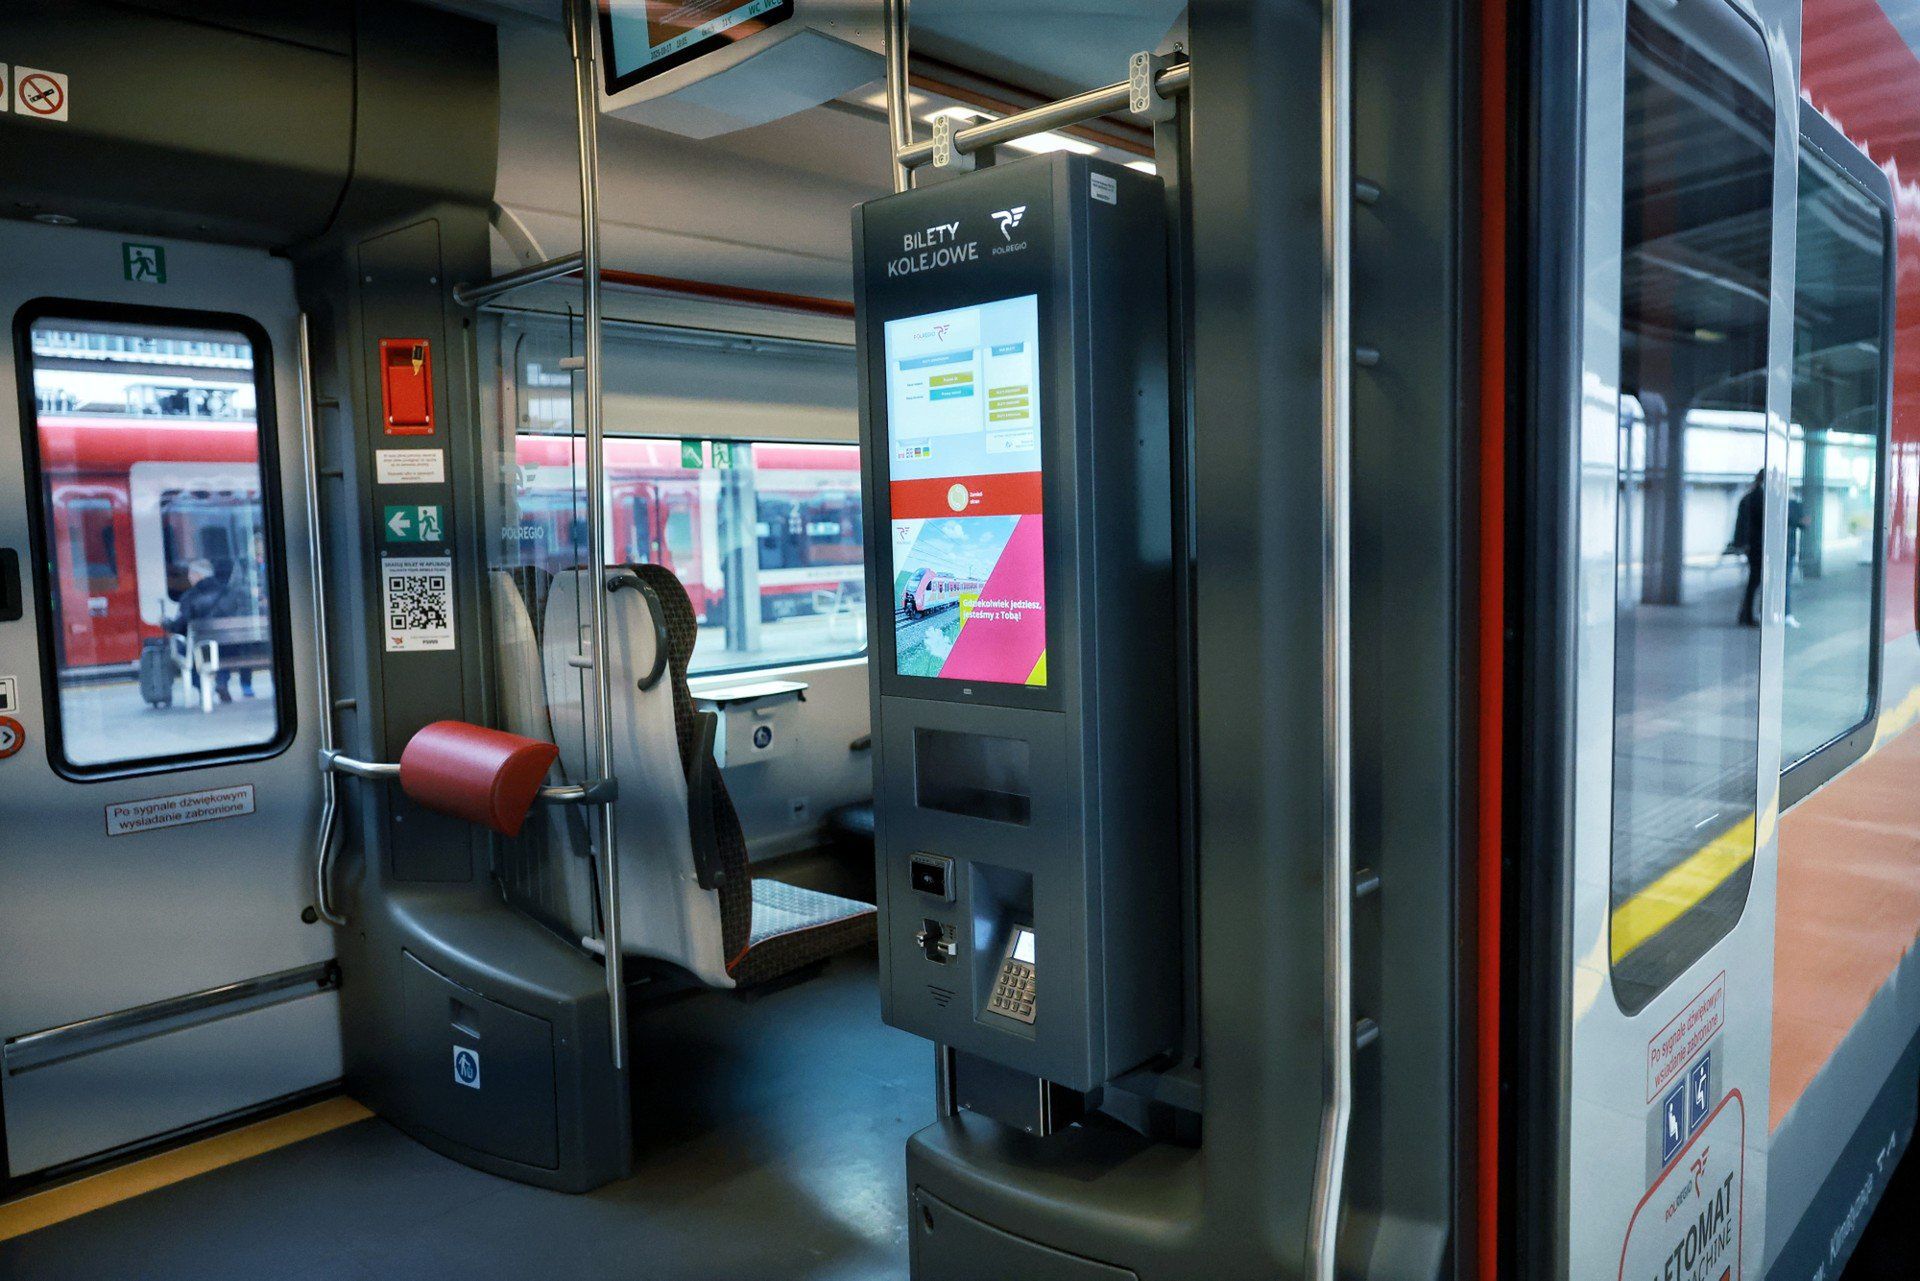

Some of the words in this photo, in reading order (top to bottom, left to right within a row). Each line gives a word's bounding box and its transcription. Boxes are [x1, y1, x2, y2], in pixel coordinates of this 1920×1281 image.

[748, 2, 761, 15] WC
[903, 221, 960, 252] BILETY
[991, 241, 1027, 256] POLREGIO
[887, 241, 979, 278] KOLEJOWE
[501, 526, 545, 540] POLREGIO
[963, 599, 1010, 609] Gdziekolwiek
[114, 807, 130, 817] Po
[133, 800, 177, 816] sygnale
[179, 790, 247, 808] dźwiękowym
[185, 802, 244, 819] zabronione
[1650, 1048, 1660, 1067] Po
[1662, 1022, 1686, 1058] sygnale
[1687, 1013, 1719, 1055] zabronione
[1665, 1180, 1693, 1223] POLREGIO
[1654, 1171, 1734, 1281] ETOMAT
